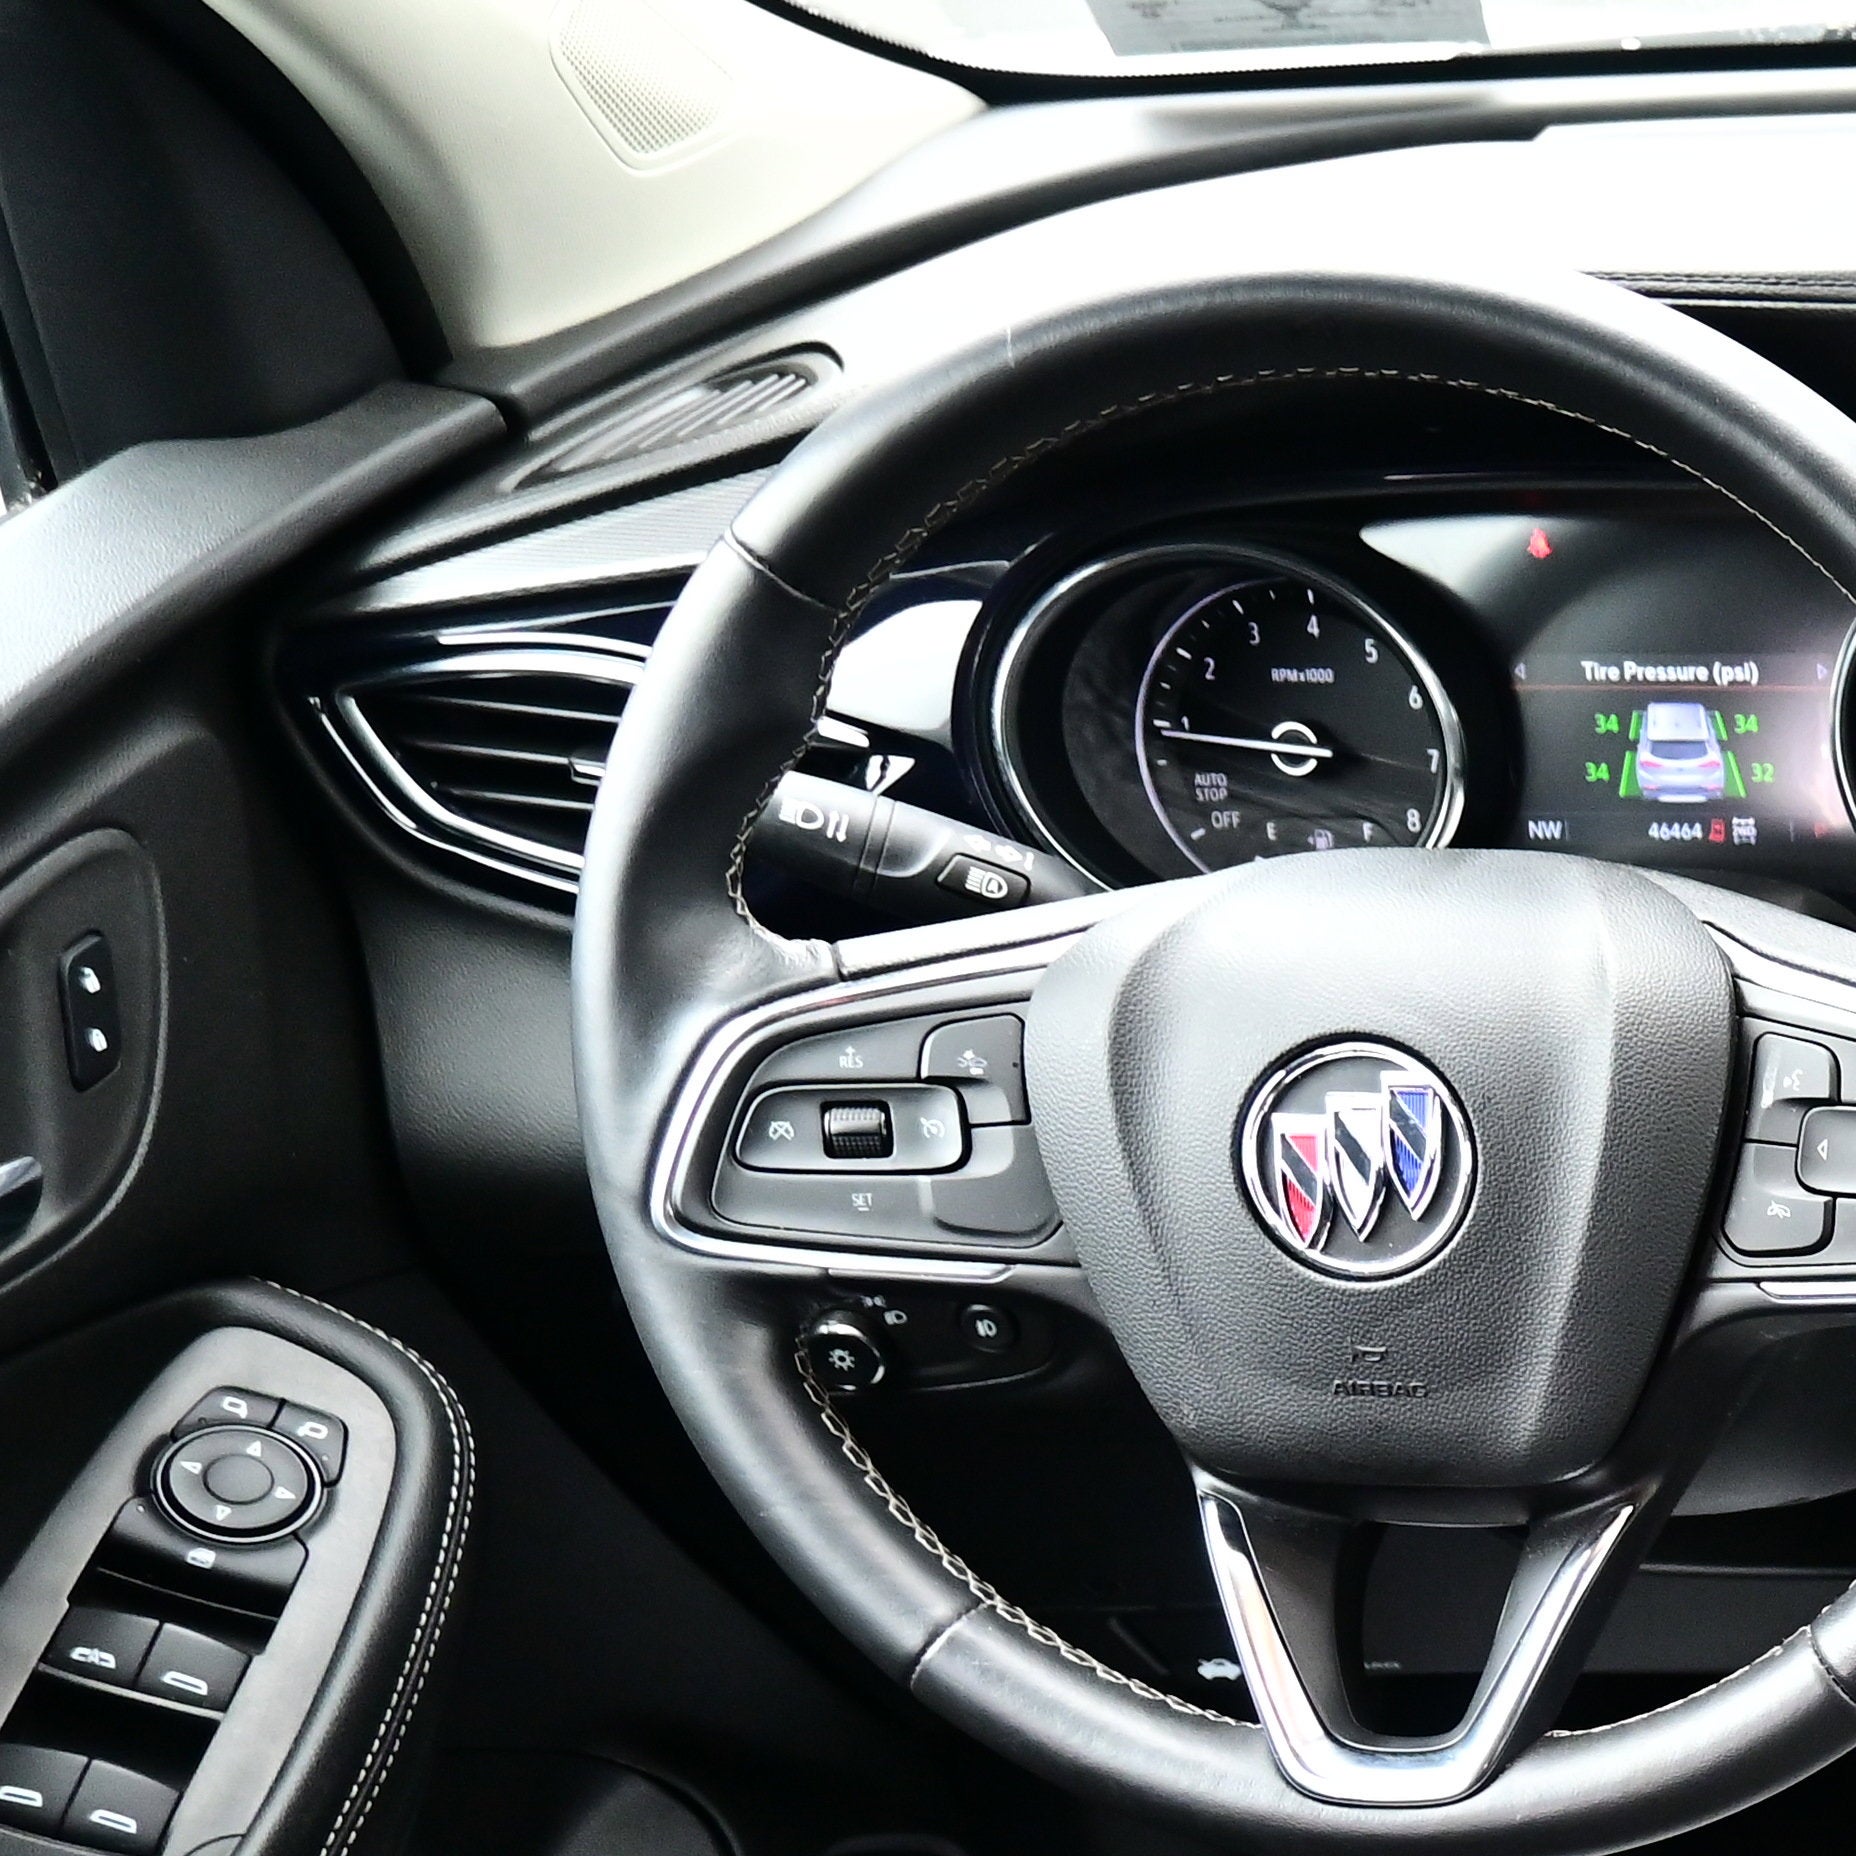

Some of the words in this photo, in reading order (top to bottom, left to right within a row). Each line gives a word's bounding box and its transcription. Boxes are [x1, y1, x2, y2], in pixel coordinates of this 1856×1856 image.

[1248, 622, 1261, 646] 3
[1307, 614, 1320, 639] 4
[1364, 638, 1379, 664] 5
[1203, 658, 1216, 681] 2
[1270, 667, 1335, 684] RPMx1000
[1581, 660, 1621, 682] Tire
[1623, 660, 1709, 683] Pressure
[1712, 661, 1760, 686] (psi)
[1409, 685, 1424, 711] 6
[1180, 715, 1190, 731] 1
[1594, 713, 1621, 734] 34
[1733, 713, 1761, 734] 34
[1426, 748, 1440, 775] 7
[1584, 761, 1612, 783] 34
[1194, 773, 1228, 787] AUTO
[1751, 762, 1776, 784] 32
[1195, 787, 1229, 802] STOP
[1210, 810, 1242, 831] OFF
[1266, 821, 1277, 840] E
[1406, 808, 1422, 834] 8
[1527, 820, 1564, 841] NW
[1362, 822, 1374, 843] F
[1648, 821, 1703, 842] 46464
[851, 1192, 873, 1207] SET
[1333, 1380, 1428, 1398] AIRBAG
